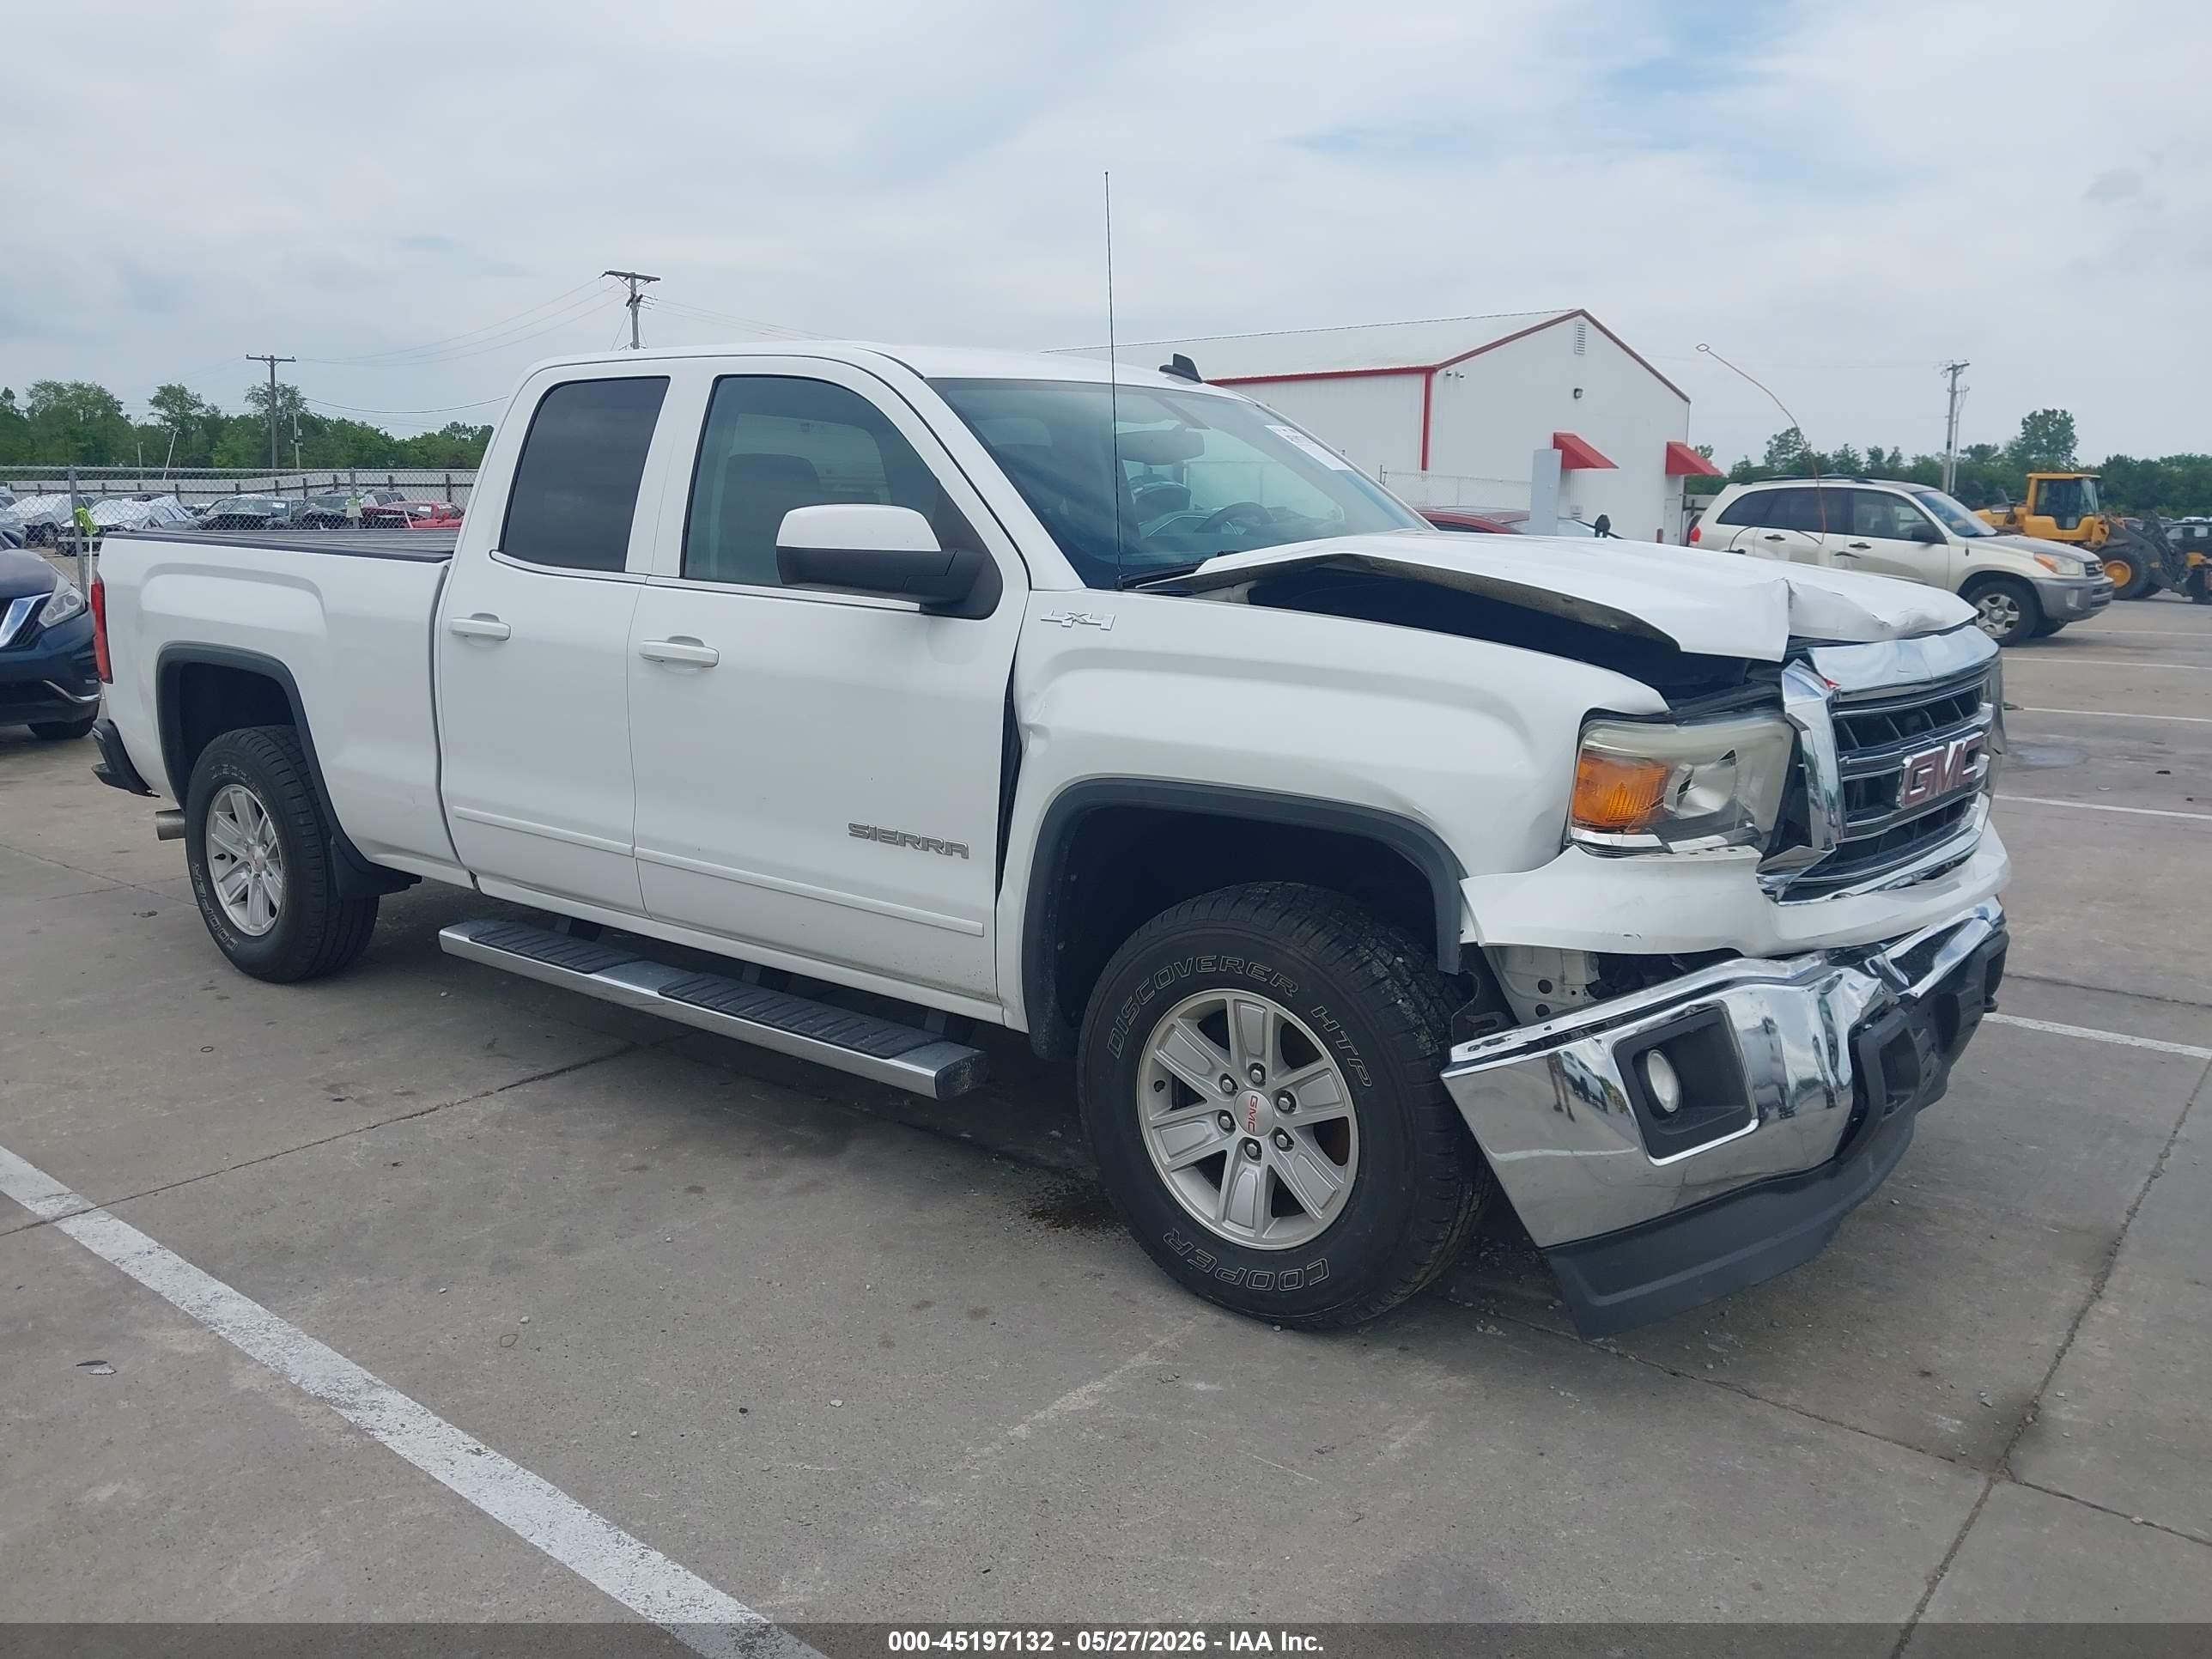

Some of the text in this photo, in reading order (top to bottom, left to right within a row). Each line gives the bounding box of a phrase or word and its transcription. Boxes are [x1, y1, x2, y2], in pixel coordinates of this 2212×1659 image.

[1897, 731, 1990, 808] GMC
[847, 822, 969, 860] SIERRA
[1107, 955, 1373, 1087] DISCOVERER HTP
[1248, 1095, 1258, 1133] GMC
[1163, 1227, 1330, 1291] COOPER
